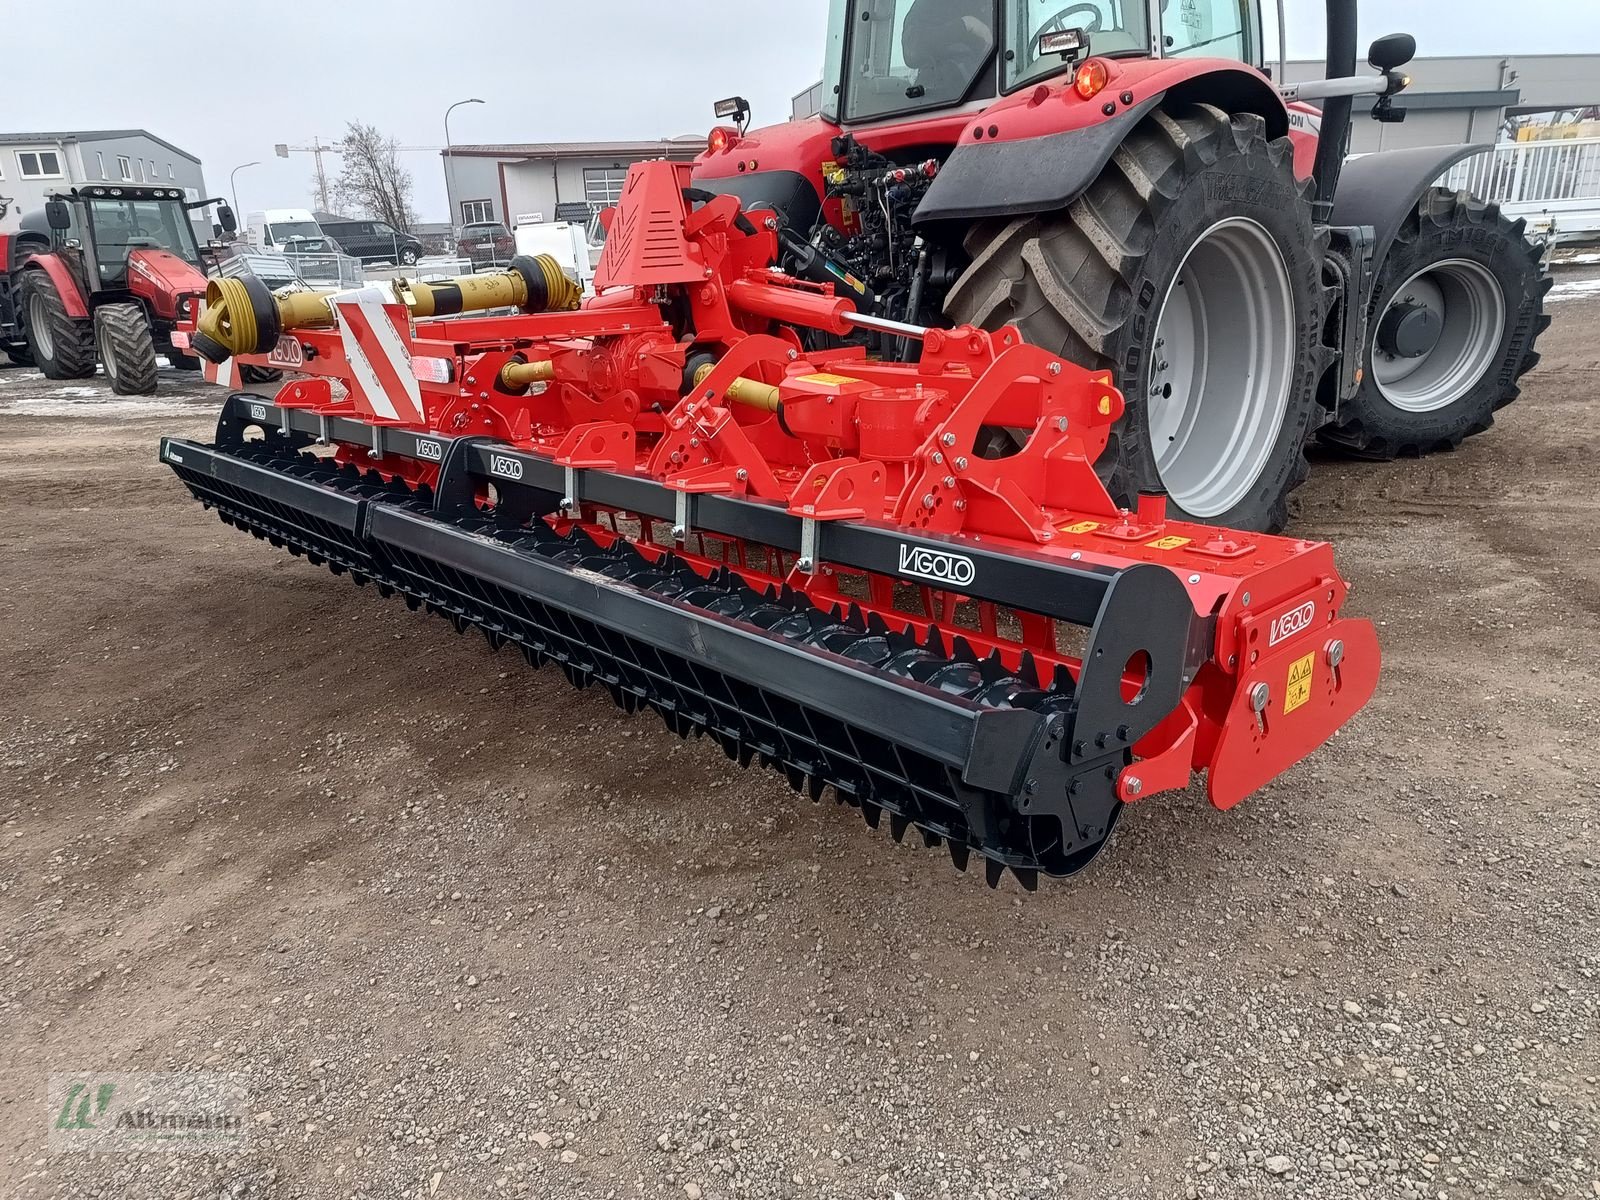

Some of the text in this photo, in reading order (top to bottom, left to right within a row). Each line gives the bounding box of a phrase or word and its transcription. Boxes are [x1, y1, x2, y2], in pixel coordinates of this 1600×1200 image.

[267, 336, 302, 367] IGOLO
[416, 438, 442, 460] VIGOLO
[490, 454, 523, 480] VIGOLO
[899, 543, 976, 586] VIGOLO
[1269, 600, 1315, 647] VIGOLO
